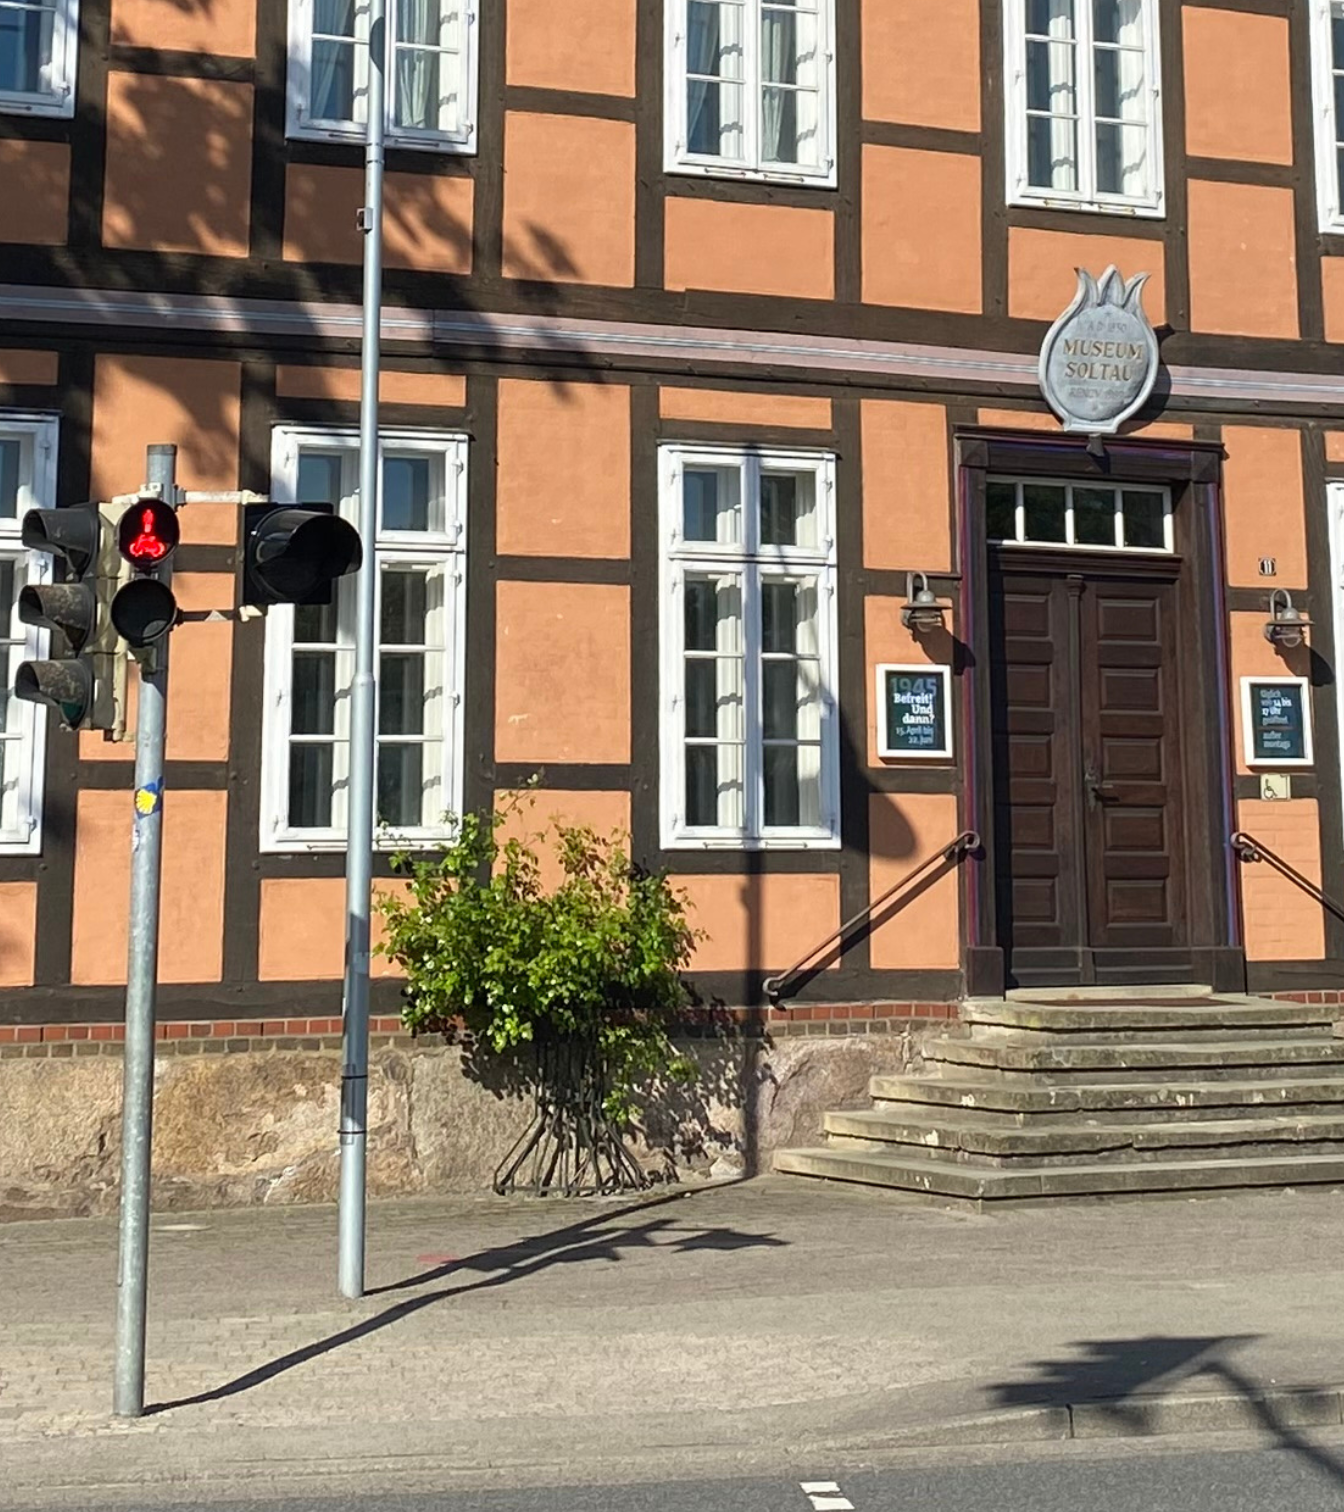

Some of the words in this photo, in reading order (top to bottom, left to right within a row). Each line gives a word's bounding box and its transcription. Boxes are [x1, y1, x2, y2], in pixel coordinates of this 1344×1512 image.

[1062, 338, 1144, 360] MUSEUM
[1064, 361, 1133, 382] SOLTAU
[890, 677, 938, 697] 1945
[893, 692, 933, 704] Befreit!
[911, 702, 933, 715] Und
[902, 713, 935, 724] dann?
